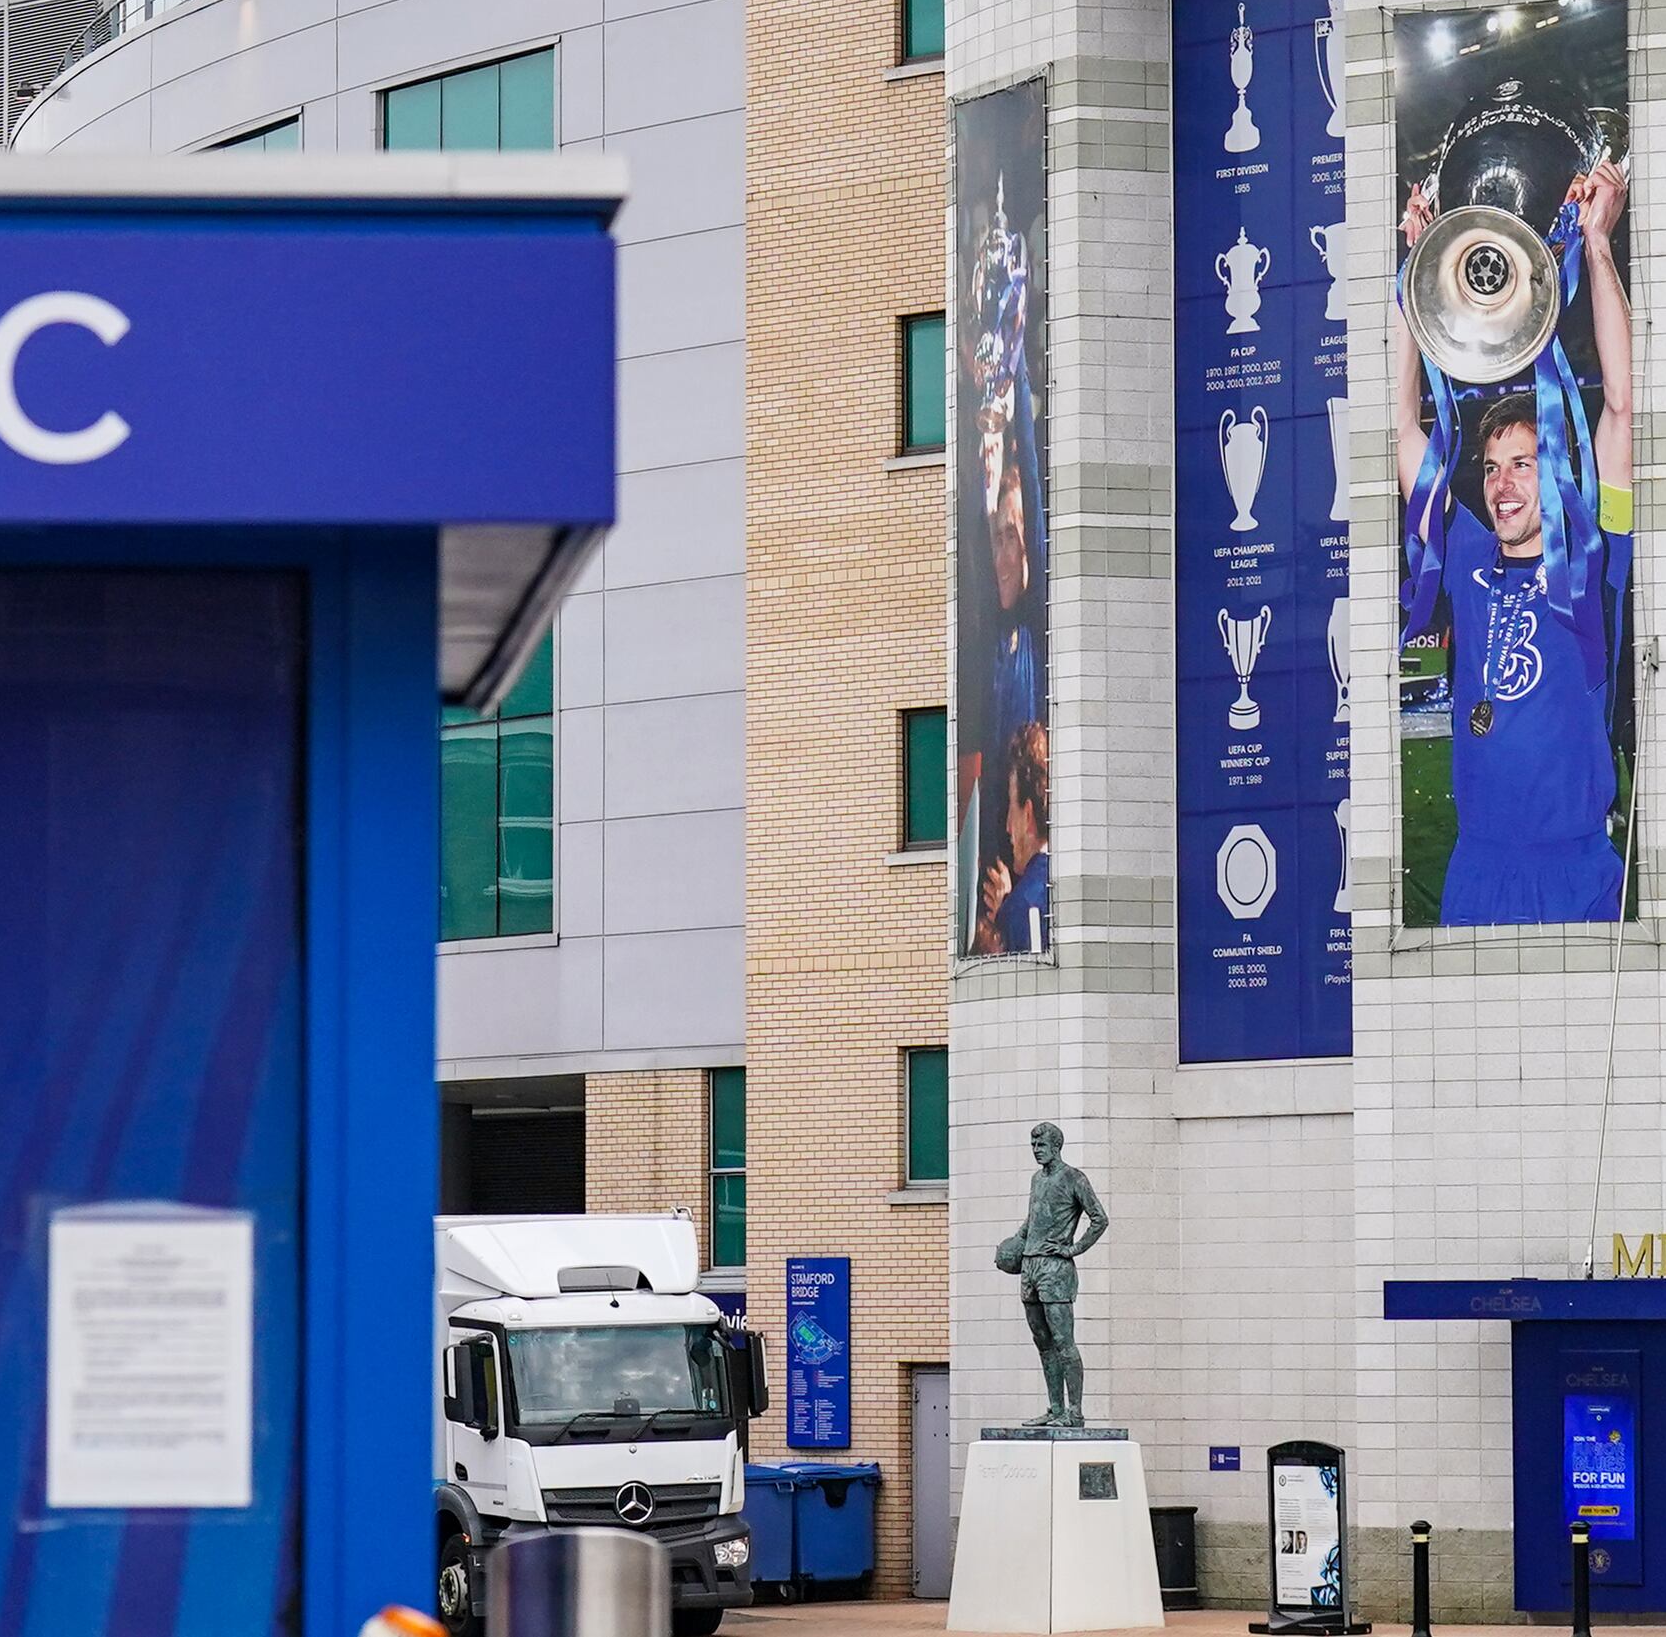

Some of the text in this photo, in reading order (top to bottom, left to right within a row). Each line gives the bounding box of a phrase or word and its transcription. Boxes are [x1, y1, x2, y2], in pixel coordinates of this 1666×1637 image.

[1312, 154, 1343, 165] PREMIER
[1216, 164, 1269, 179] FIRST DIVISION
[1333, 170, 1346, 180] 200
[1235, 183, 1250, 194] 1955
[1230, 346, 1256, 357] FA CUP
[1320, 537, 1338, 547] UEFA
[1214, 543, 1275, 558] UEFA CHAMPIONS
[1330, 550, 1349, 560] LEAG
[1231, 558, 1258, 570] LEAGUE
[1246, 576, 1261, 586] 2021
[1498, 645, 1509, 669] FINAL
[1336, 737, 1350, 747] UEF
[1228, 744, 1263, 755] UEFA CUP
[1255, 756, 1271, 767] CUP
[1326, 751, 1350, 761] SUPER
[1242, 934, 1252, 943] FA
[1329, 928, 1346, 938] FIFA
[1212, 945, 1282, 958] COMMUNITY SHIELD
[1249, 977, 1267, 987] 2009
[790, 1272, 835, 1285] STAMFORD
[791, 1286, 820, 1298] BRIDGE
[1470, 1297, 1542, 1312] CHELSEA
[1566, 1373, 1630, 1387] CHELSEA
[1573, 1472, 1625, 1483] FOR FUN
